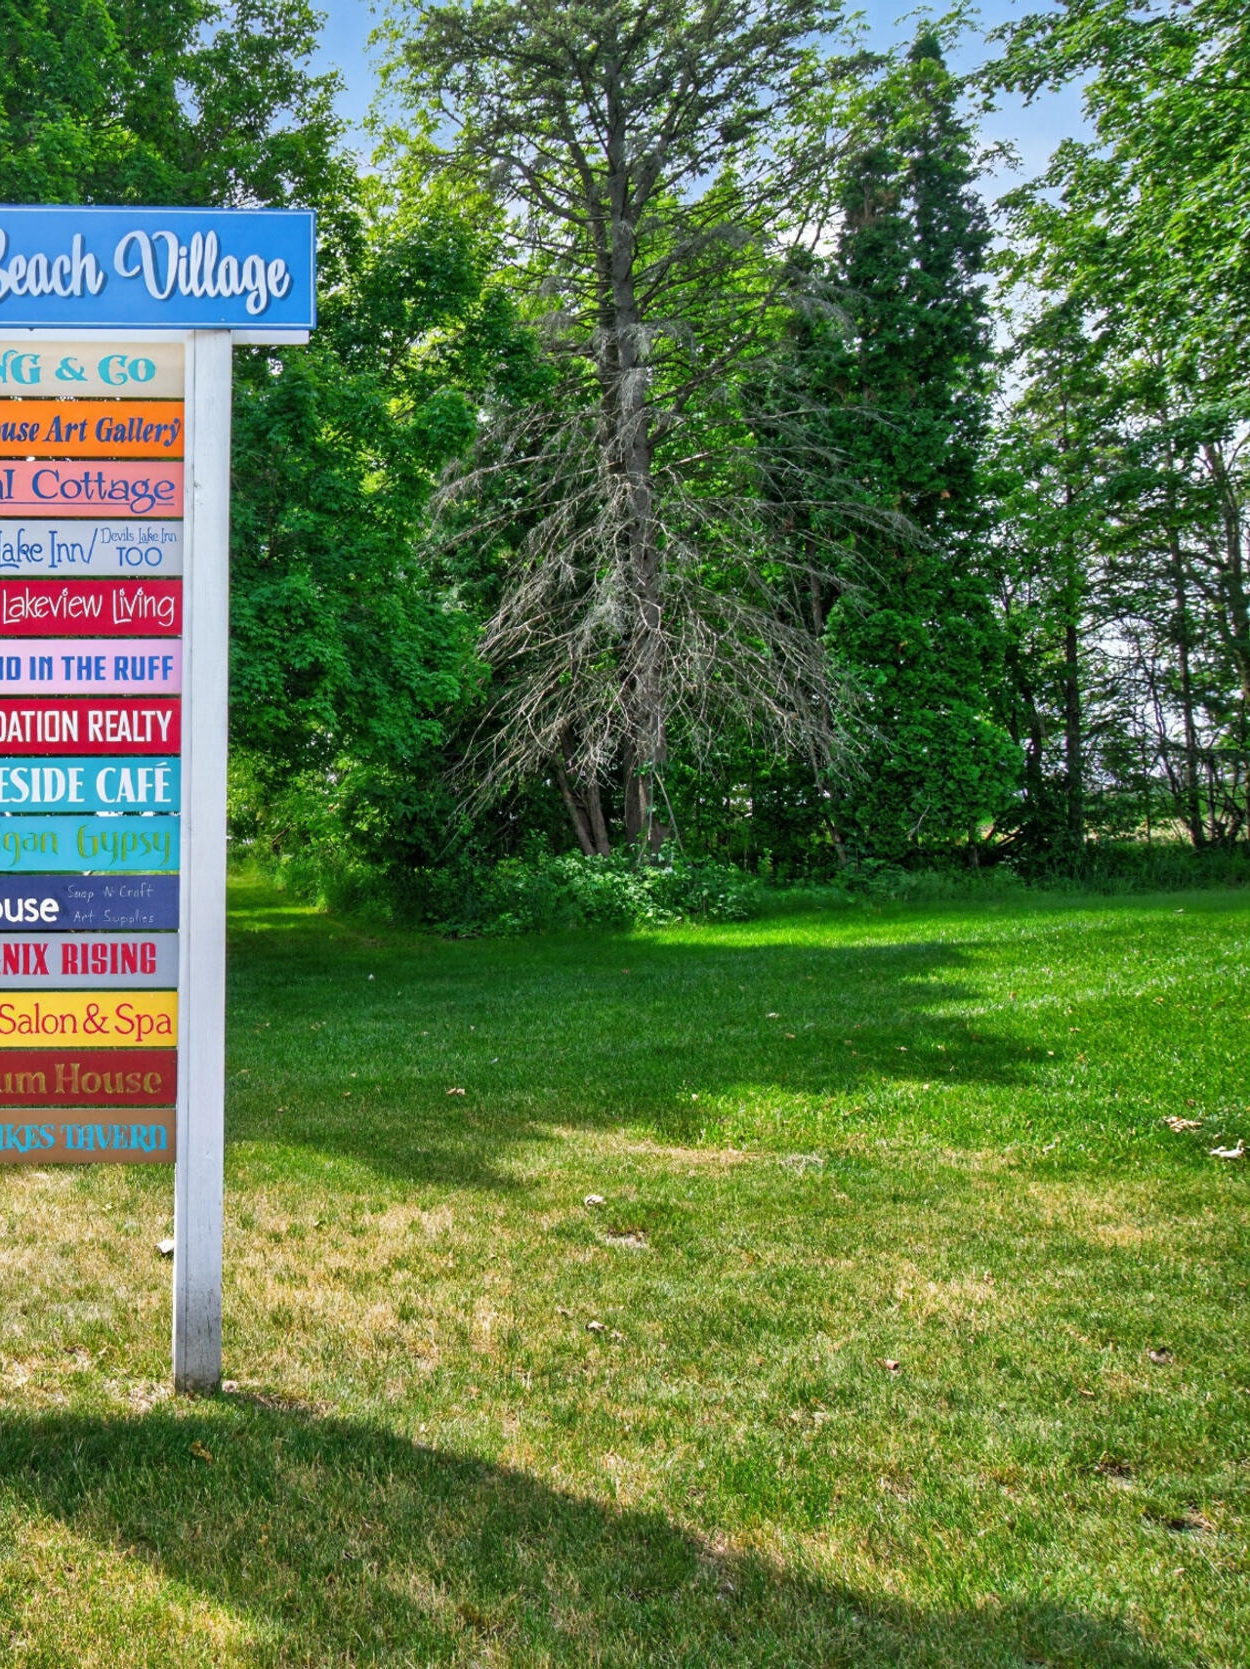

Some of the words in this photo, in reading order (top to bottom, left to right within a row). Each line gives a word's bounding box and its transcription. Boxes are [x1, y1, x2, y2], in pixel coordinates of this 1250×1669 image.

[114, 230, 292, 315] Village
[54, 356, 88, 382] &
[43, 416, 87, 442] Art
[95, 417, 181, 447] Gallery
[32, 469, 175, 514] Cottage
[100, 527, 135, 544] Devils
[137, 526, 159, 544] Lake
[161, 527, 177, 544] Inn
[116, 546, 163, 567] TOO
[3, 588, 102, 624] Lakeview
[112, 587, 175, 626] Living
[30, 656, 52, 681] IN
[61, 656, 106, 681] THE
[114, 656, 174, 681] RUFF
[88, 710, 173, 742] REALTY
[96, 762, 172, 803] CAFÉ
[76, 825, 170, 866] Gypsy
[61, 942, 157, 975] RISING
[82, 1003, 111, 1034] &
[114, 1003, 172, 1042] Spa
[53, 1062, 162, 1094] House
[60, 1124, 167, 1152] TAVERN
